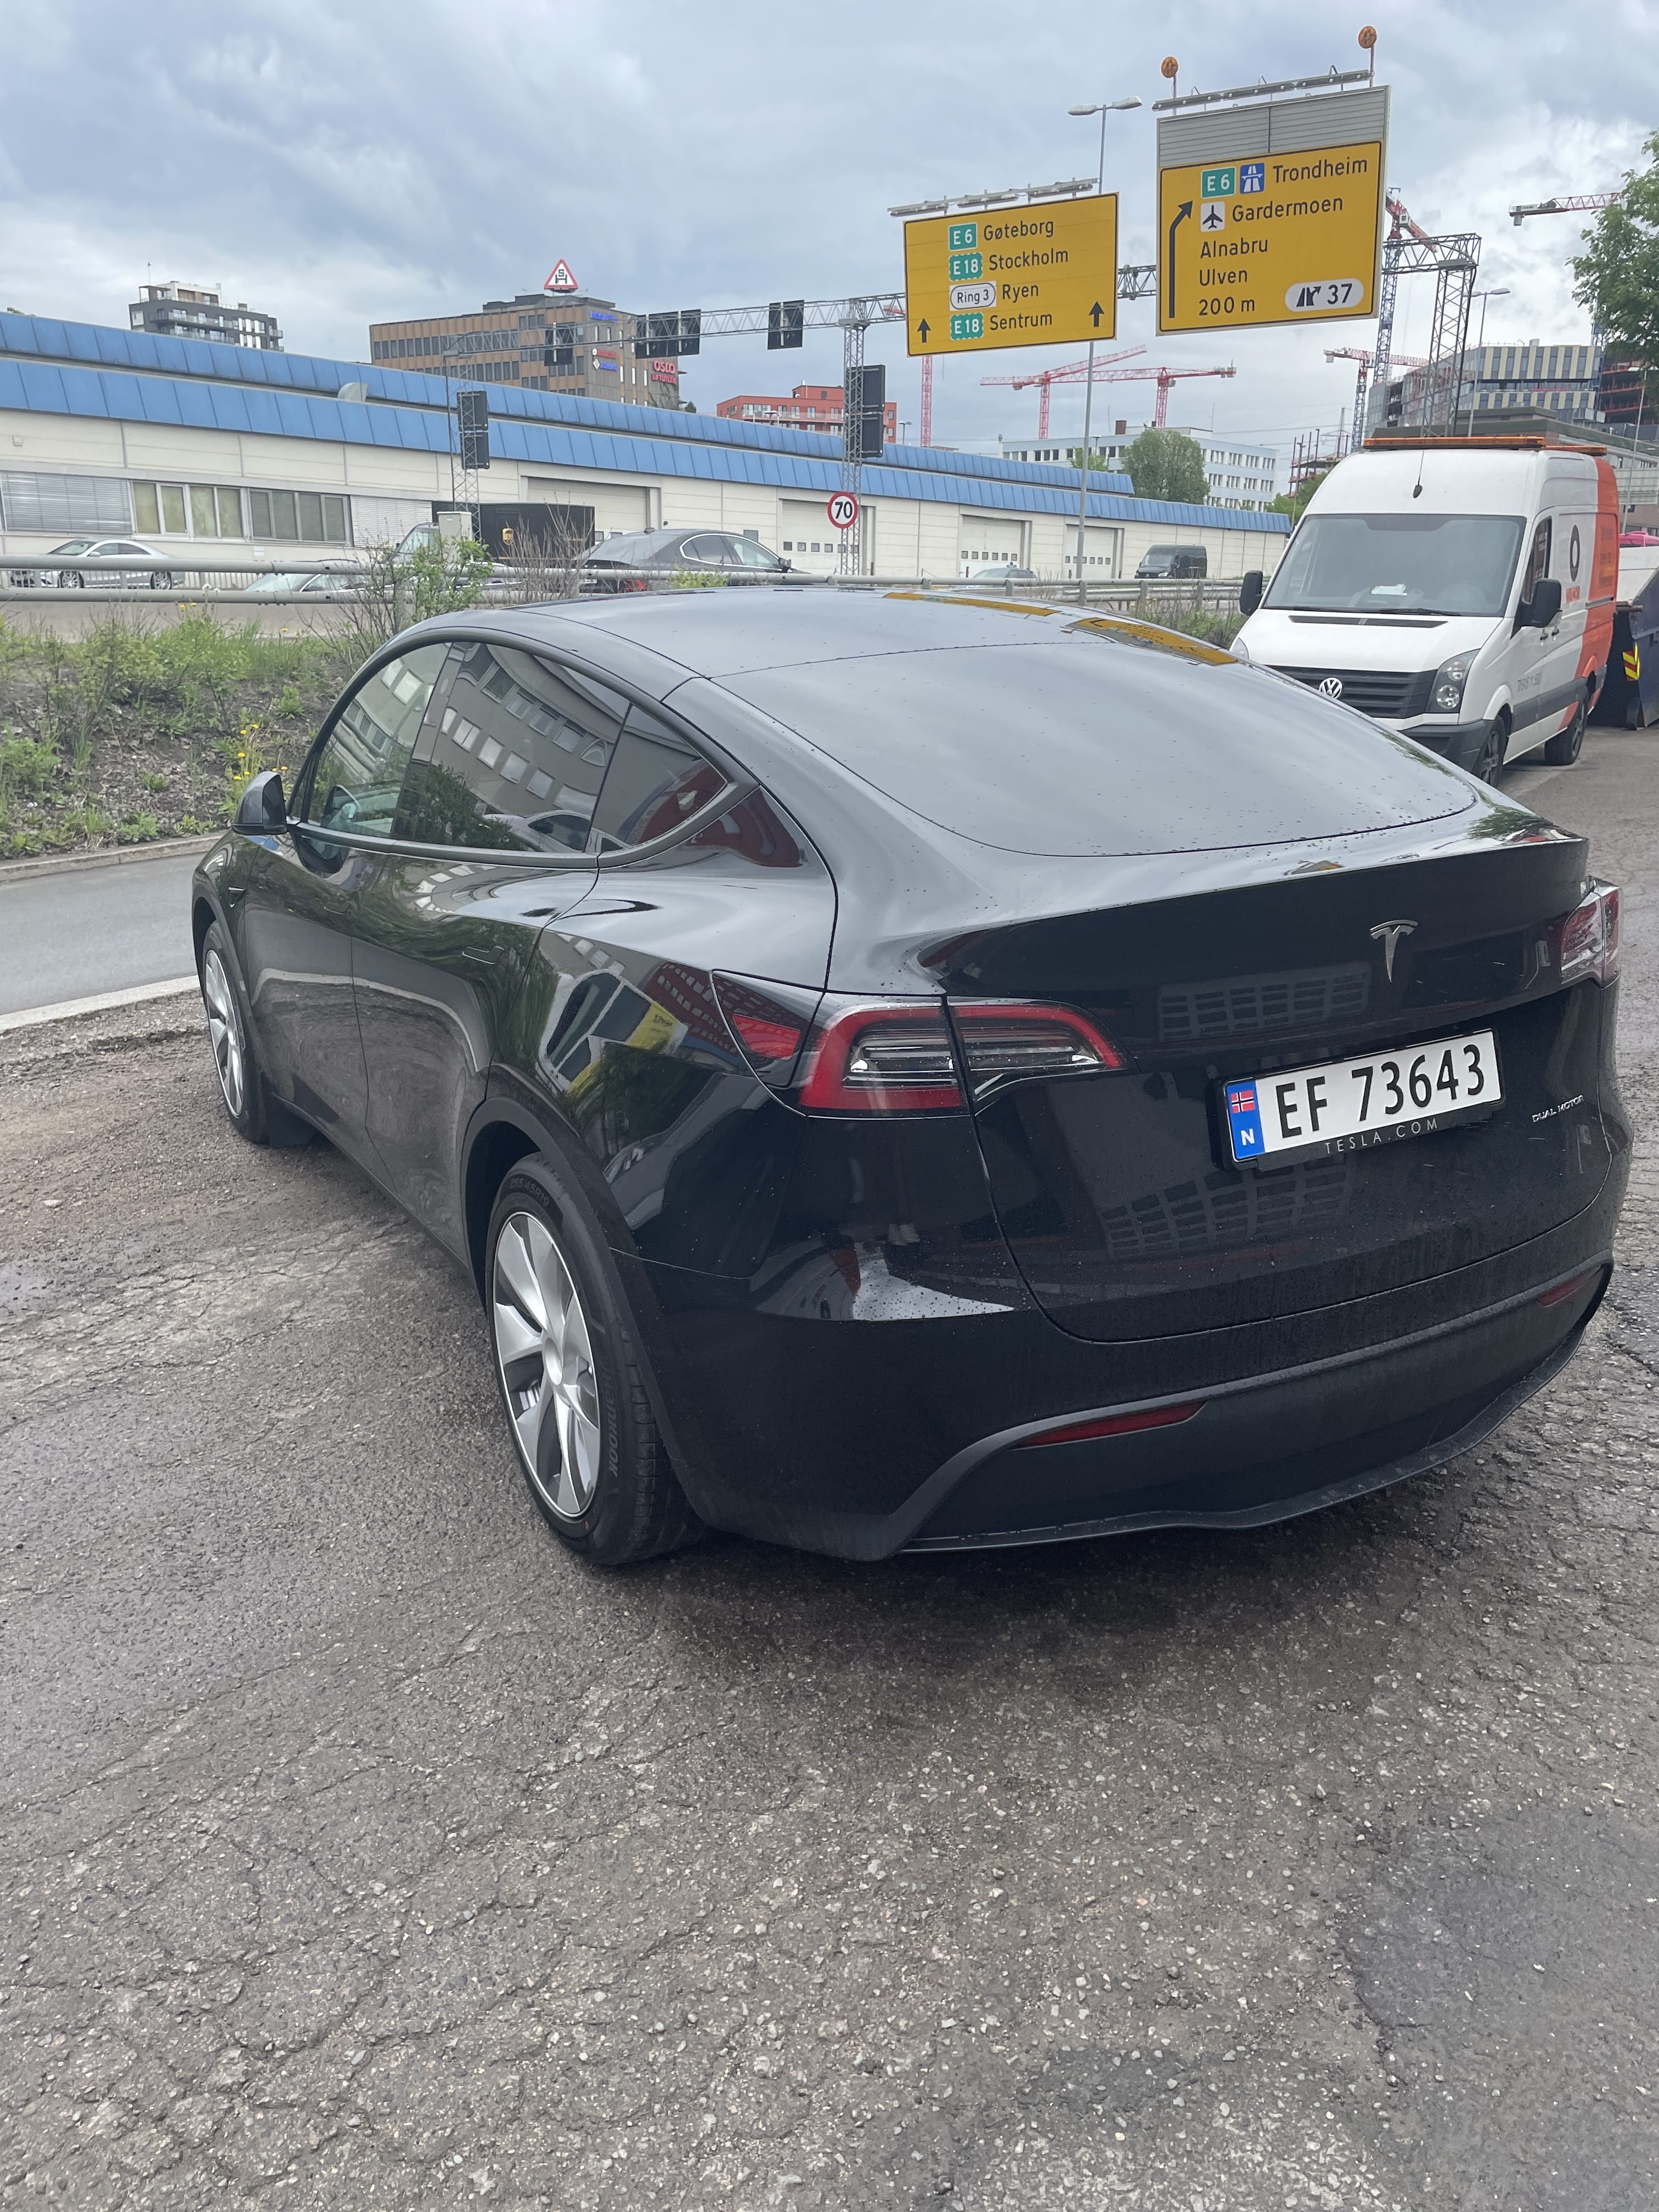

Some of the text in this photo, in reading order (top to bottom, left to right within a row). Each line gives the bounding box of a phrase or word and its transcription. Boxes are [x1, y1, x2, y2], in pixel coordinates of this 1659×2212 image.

[1272, 157, 1368, 183] Trondheim
[1232, 197, 1343, 222] Gardermoen
[984, 220, 1054, 241] Gøteborg
[989, 247, 1069, 271] Stockholm
[1200, 238, 1268, 259] Alnabru
[1199, 269, 1248, 286] Ulven
[957, 283, 1039, 305] Ring 3 Ryen
[1327, 283, 1353, 305] 37
[1199, 297, 1255, 316] 200 m
[990, 313, 1052, 330] Sentrum
[653, 360, 676, 374] OSLO
[834, 501, 853, 519] 70
[1276, 1044, 1485, 1139] EF 73643
[1532, 1094, 1584, 1123] DUAL MOTOR
[1241, 1128, 1255, 1147] N
